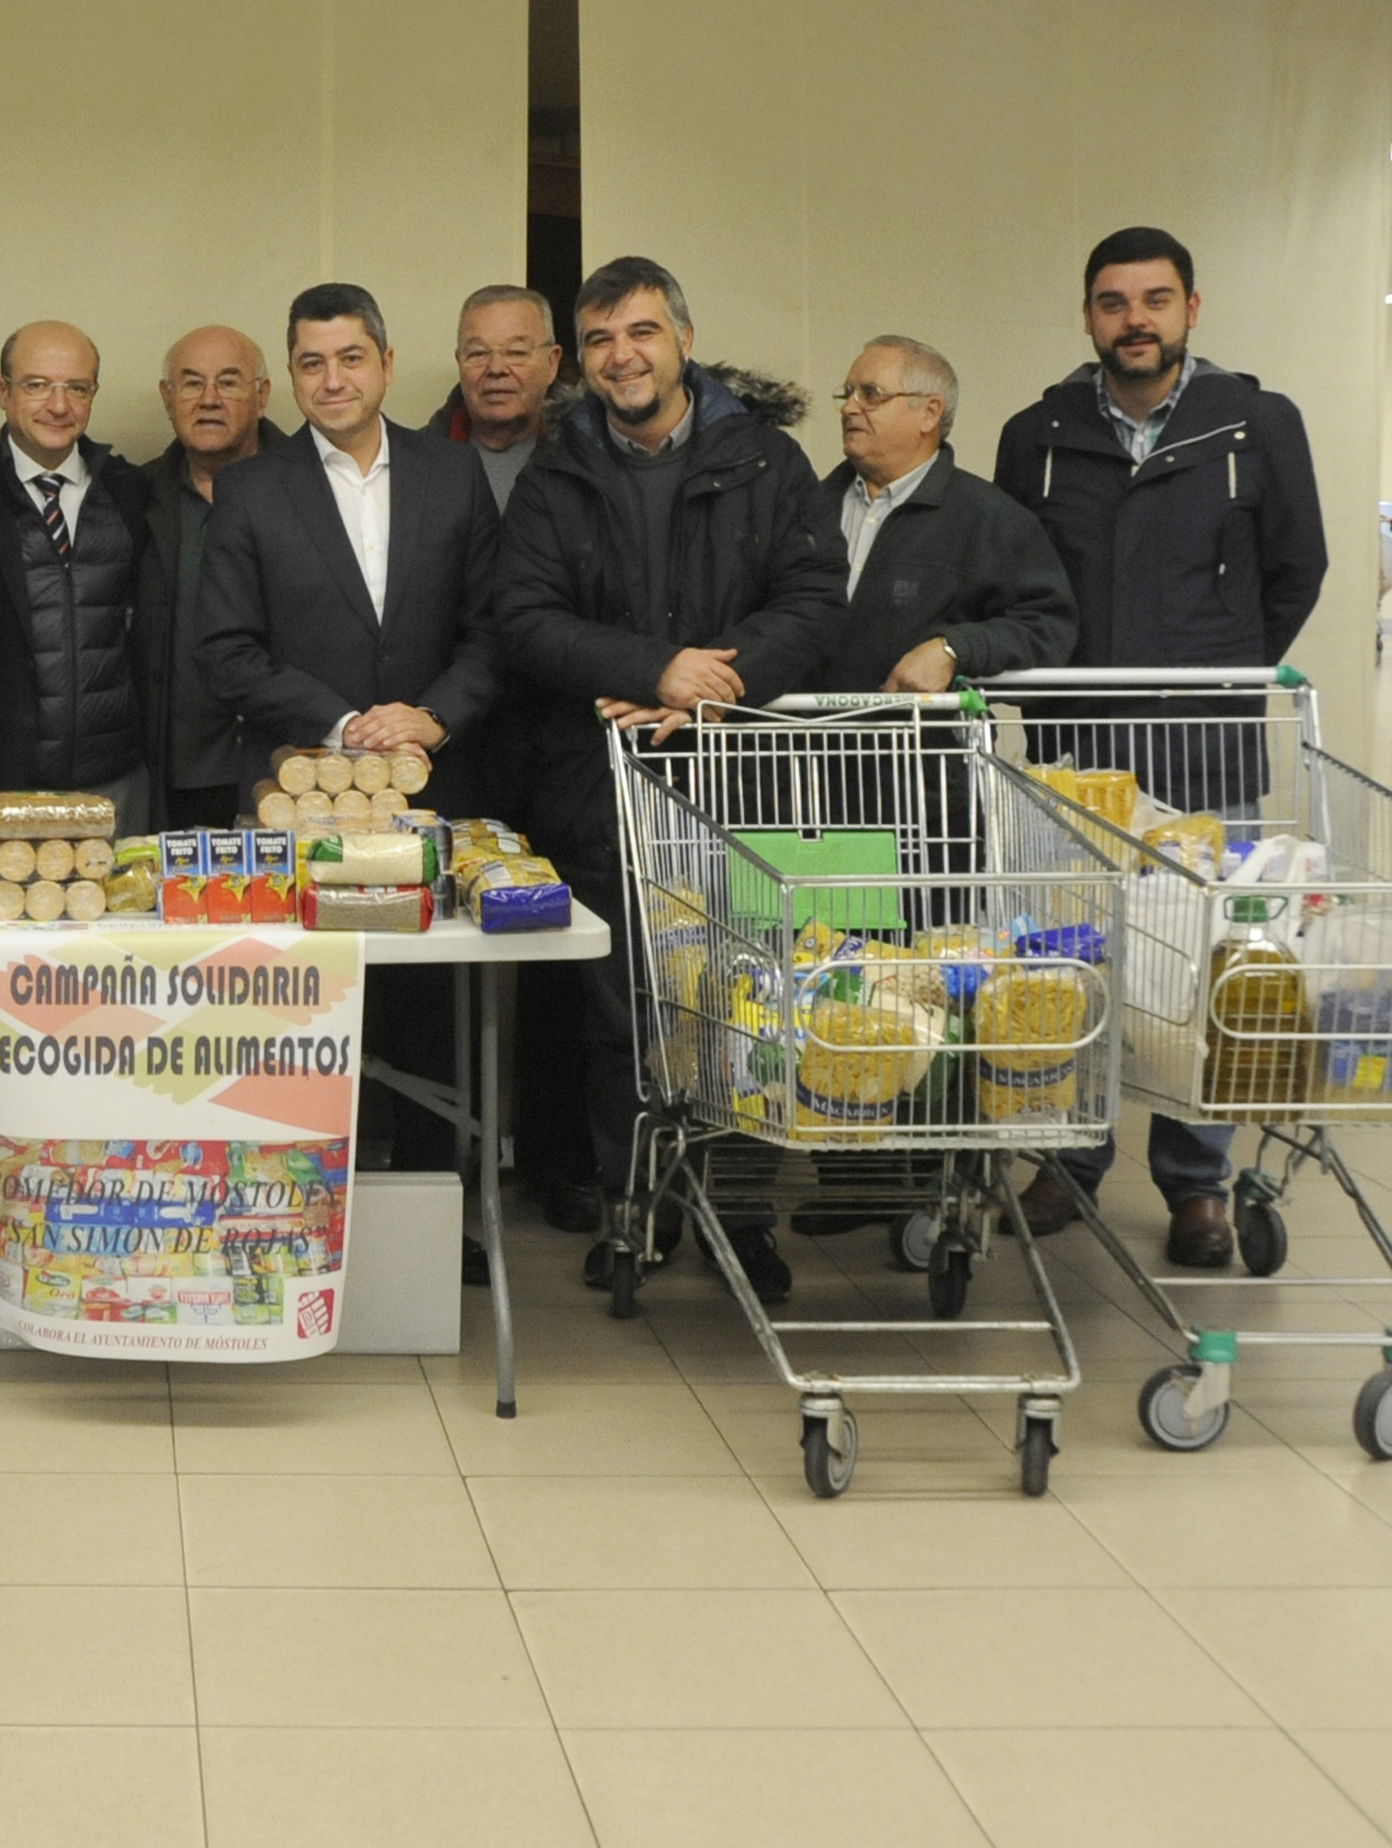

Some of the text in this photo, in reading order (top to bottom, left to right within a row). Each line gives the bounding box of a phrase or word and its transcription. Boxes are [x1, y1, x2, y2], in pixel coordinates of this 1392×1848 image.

[814, 694, 915, 707] MERCADONA
[167, 838, 197, 847] TOMATE
[211, 837, 242, 846] TOMATE
[256, 837, 287, 846] TOMATE
[171, 847, 193, 856] FRITO
[215, 846, 238, 855] FRITO
[260, 845, 283, 854] FRITO
[9, 953, 321, 1006] CAMPAÑA SOLIDARIA
[146, 1035, 184, 1076] DE
[194, 1034, 351, 1077] ALIMENTOS
[133, 1180, 175, 1207] DE
[67, 1225, 164, 1254] SIMON
[171, 1226, 216, 1254] DE
[18, 1319, 269, 1351] COLABORA EL AYUNTAMIENTO DE MÓSTOLES
